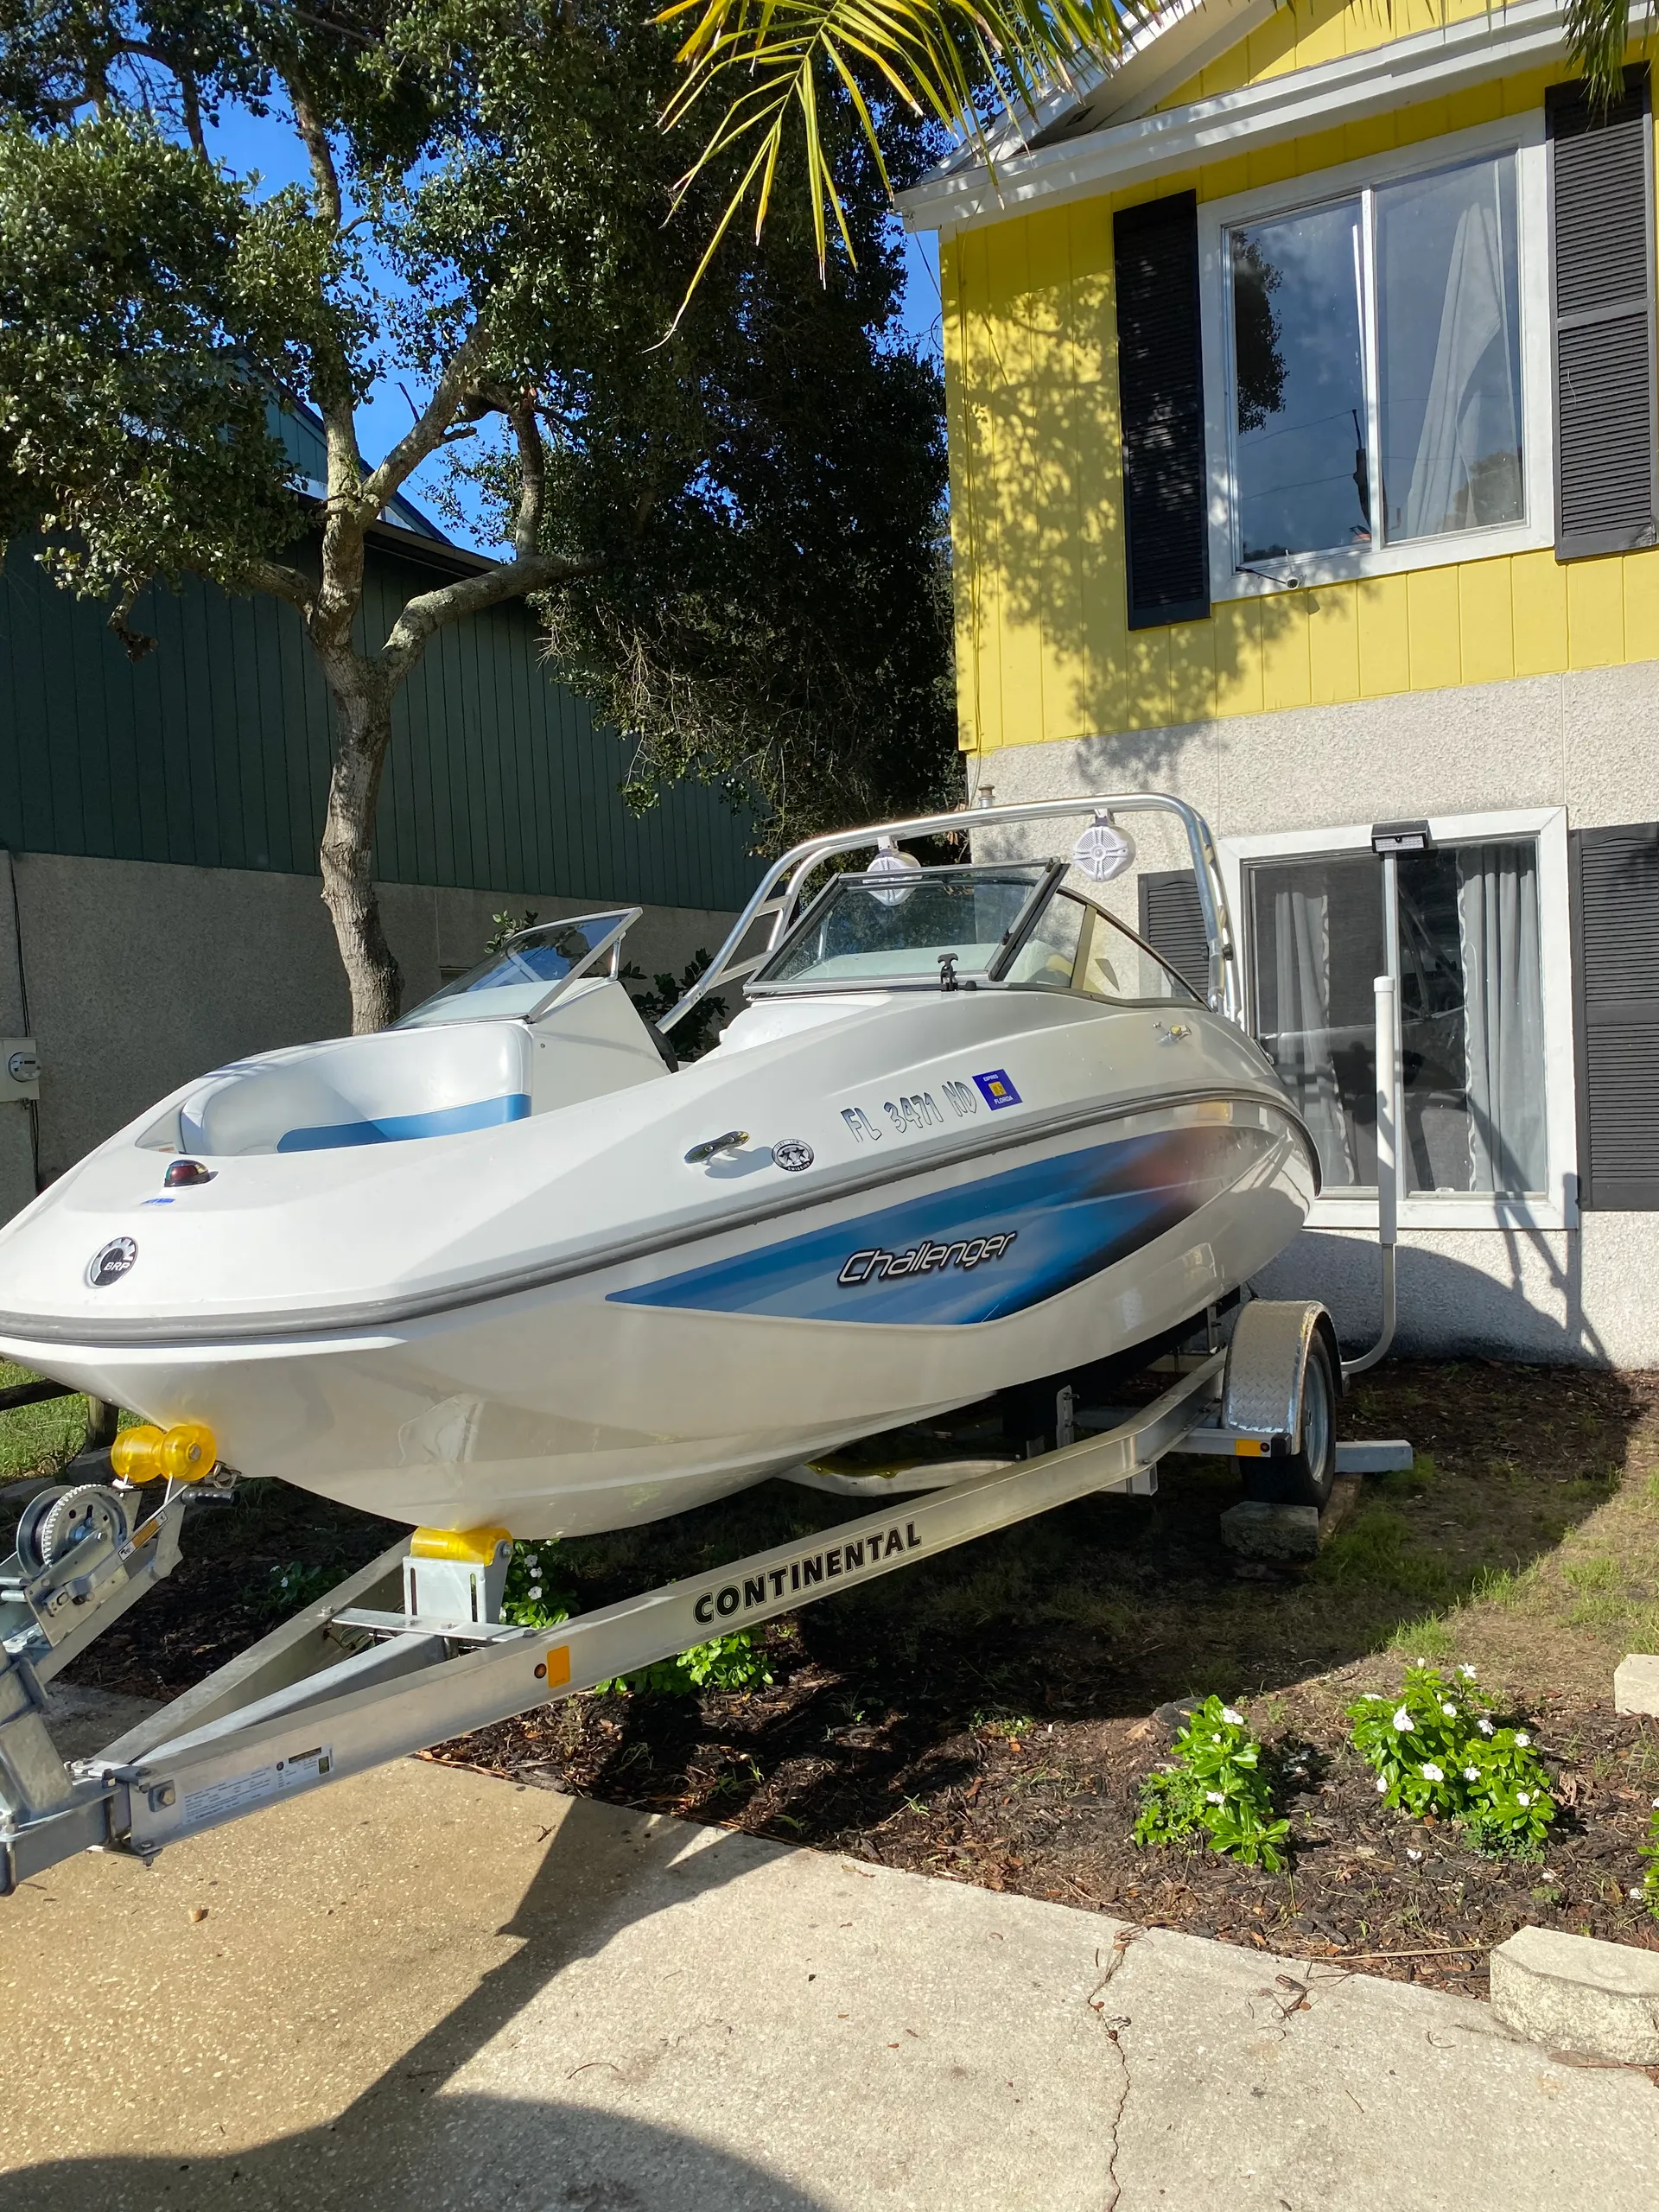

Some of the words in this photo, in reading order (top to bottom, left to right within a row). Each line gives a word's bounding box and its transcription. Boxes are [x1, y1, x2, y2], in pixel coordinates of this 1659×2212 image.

[840, 1107, 882, 1142] FL
[883, 1091, 944, 1134] 3471
[941, 1081, 977, 1117] ND
[994, 1095, 1014, 1105] FLORIDA
[103, 1262, 130, 1272] BRP
[837, 1230, 1018, 1286] Challenger
[693, 1521, 923, 1625] CONTINENTAL
